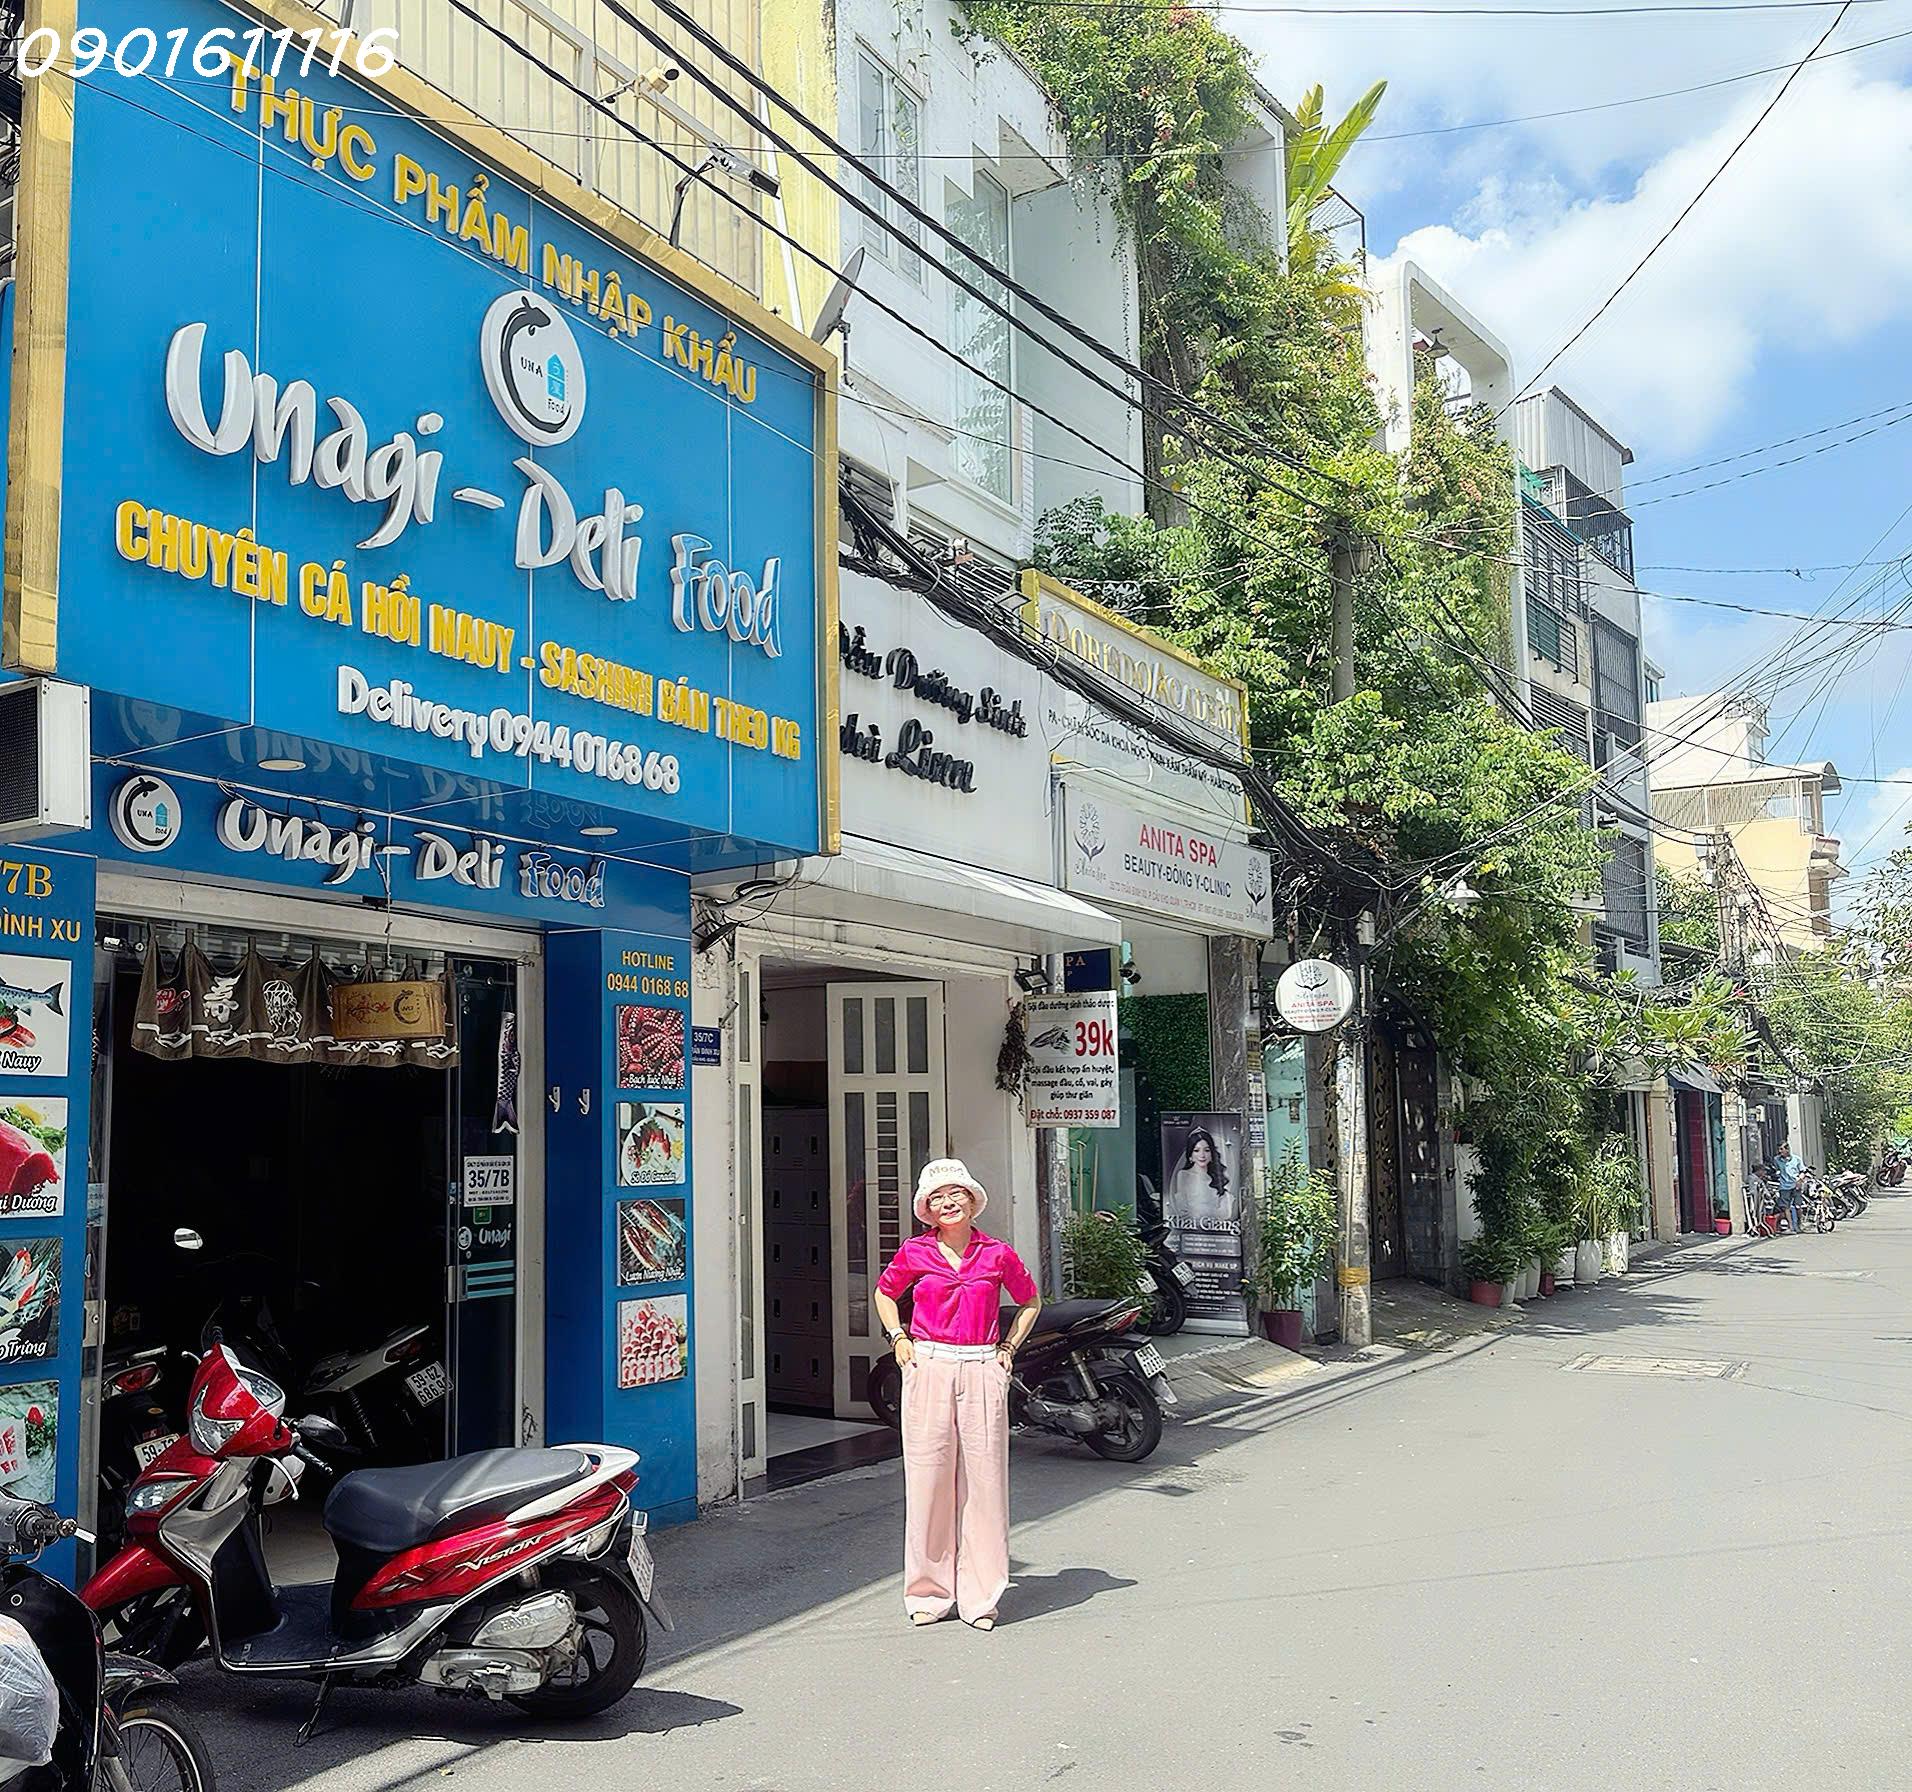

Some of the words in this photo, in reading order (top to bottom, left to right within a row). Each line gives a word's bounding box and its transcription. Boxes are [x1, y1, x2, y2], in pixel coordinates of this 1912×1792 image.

[222, 51, 377, 182] THỰC
[394, 153, 530, 274] PHẨM
[543, 243, 653, 338] NHẬP
[663, 314, 758, 404] KHẨU
[520, 357, 543, 377] UNA
[165, 322, 444, 549] Unagi
[512, 457, 644, 602] Deli
[670, 533, 782, 658] Food
[116, 500, 288, 606] CHUYÊN
[299, 560, 353, 626] CÁ
[362, 573, 421, 646] HỒI
[429, 604, 515, 673] NAUY
[540, 641, 653, 716] SASHIMI
[657, 676, 709, 733] BÁN
[713, 697, 768, 750] THEO
[771, 716, 800, 760] KG
[337, 665, 489, 758] Delivery
[217, 799, 376, 885] Unagi
[414, 831, 504, 889] Deli
[519, 852, 606, 908] Food
[1139, 824, 1185, 859] ANITA
[1189, 839, 1217, 868] SPA
[0, 862, 53, 898] 7B
[1124, 854, 1192, 888] BEAUTY-ĐÔNG
[1195, 873, 1232, 898] Y-CLINIC
[0, 908, 42, 939] ÌNH
[50, 918, 81, 942] XU
[622, 950, 674, 971] HOTLINE
[607, 973, 638, 993] 0944
[641, 977, 671, 996] 0168
[674, 980, 689, 998] 68
[693, 1031, 714, 1043] 35/7C
[1075, 1019, 1115, 1057] 39k
[2, 1052, 41, 1072] Nauy
[1063, 1109, 1083, 1120] 0937
[1085, 1109, 1099, 1120] 359
[1101, 1109, 1116, 1120] 087
[468, 1169, 510, 1189] 35/7B
[479, 1222, 512, 1248] Unagi
[9, 1340, 47, 1357] Trứng
[455, 1533, 548, 1571] VISION
